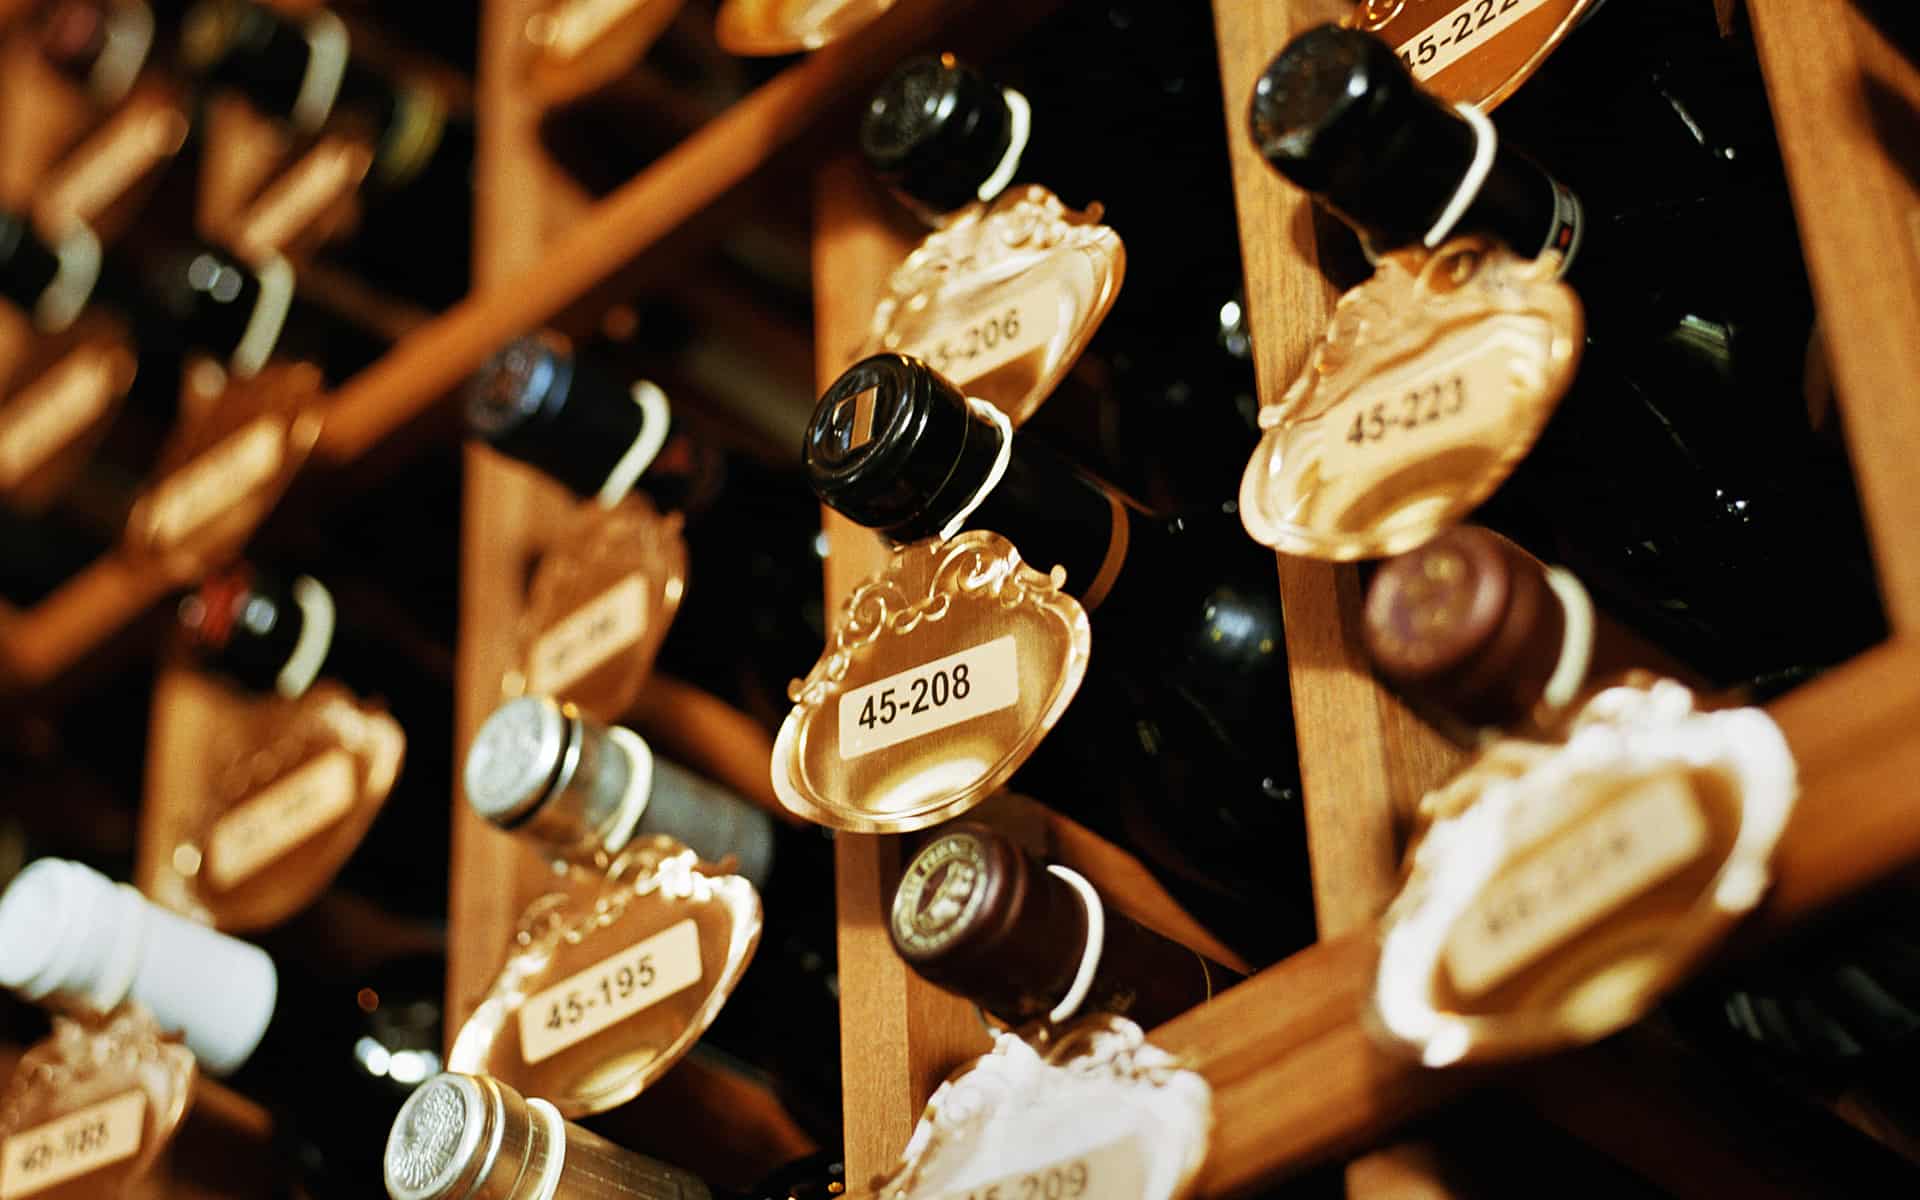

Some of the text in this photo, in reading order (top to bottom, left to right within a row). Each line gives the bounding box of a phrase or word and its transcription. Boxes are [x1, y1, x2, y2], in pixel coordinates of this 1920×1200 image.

[922, 307, 1020, 371] 5-206
[1347, 376, 1467, 444] 45-223
[858, 663, 971, 730] 45-208
[546, 955, 656, 1031] 45-195
[968, 1159, 1089, 1200] -209
